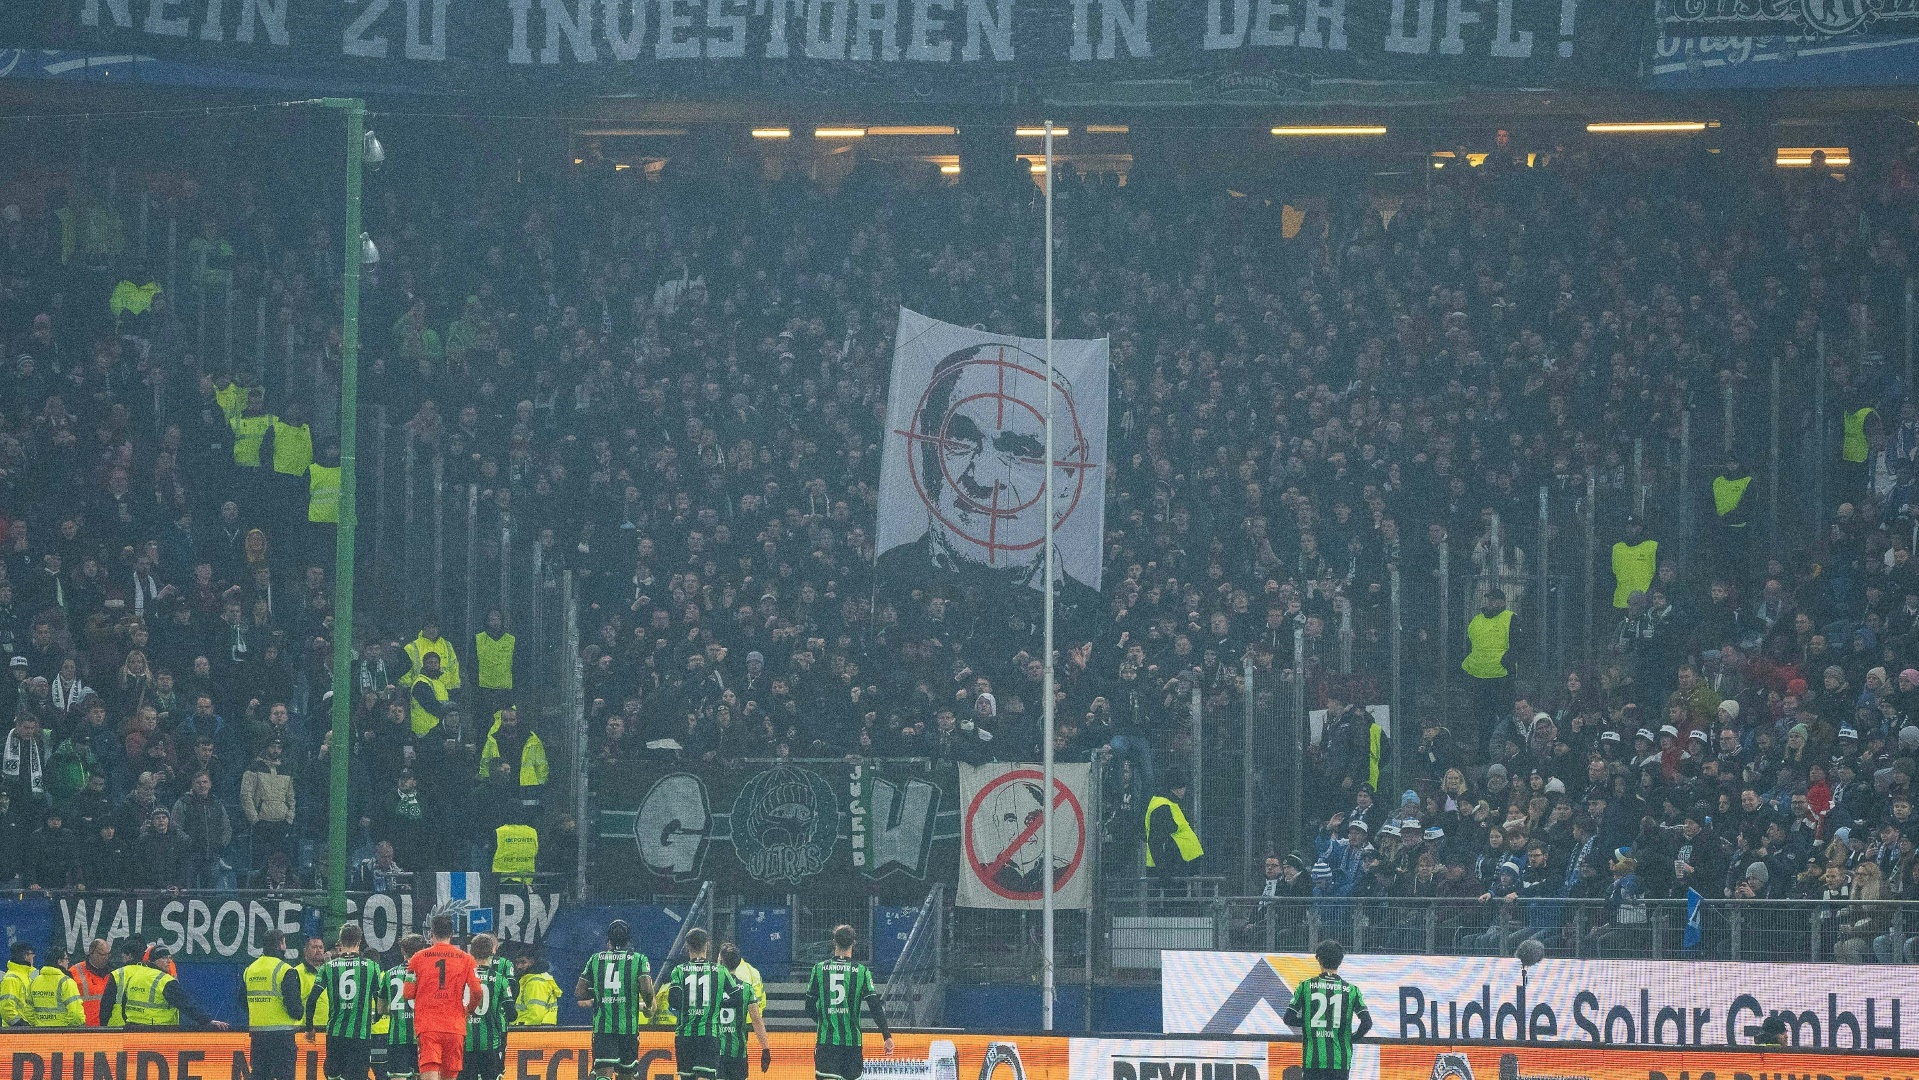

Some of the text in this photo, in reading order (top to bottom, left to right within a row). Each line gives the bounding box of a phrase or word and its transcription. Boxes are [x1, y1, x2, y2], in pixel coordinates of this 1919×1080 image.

[342, 0, 446, 61] ZU
[508, 0, 1015, 64] INVESTOREN
[1069, 0, 1151, 61] IN
[1203, 0, 1348, 50] DER
[850, 765, 867, 867] JUGEND
[748, 844, 824, 884] ULTRAS
[59, 898, 302, 959] WALSRODE
[330, 960, 360, 968] HANNOVER
[434, 958, 446, 990] 1
[604, 962, 622, 995] 4
[682, 965, 711, 973] HANNOVER
[821, 964, 851, 972] HANNOVER
[338, 968, 357, 1001] 6
[390, 977, 415, 1011] 2
[684, 974, 710, 1007] 11
[829, 973, 847, 1006] 5
[1309, 982, 1351, 993] HANNOVER 96
[1310, 992, 1343, 1029] 21
[1399, 985, 1900, 1050] Budde Solar GmbH
